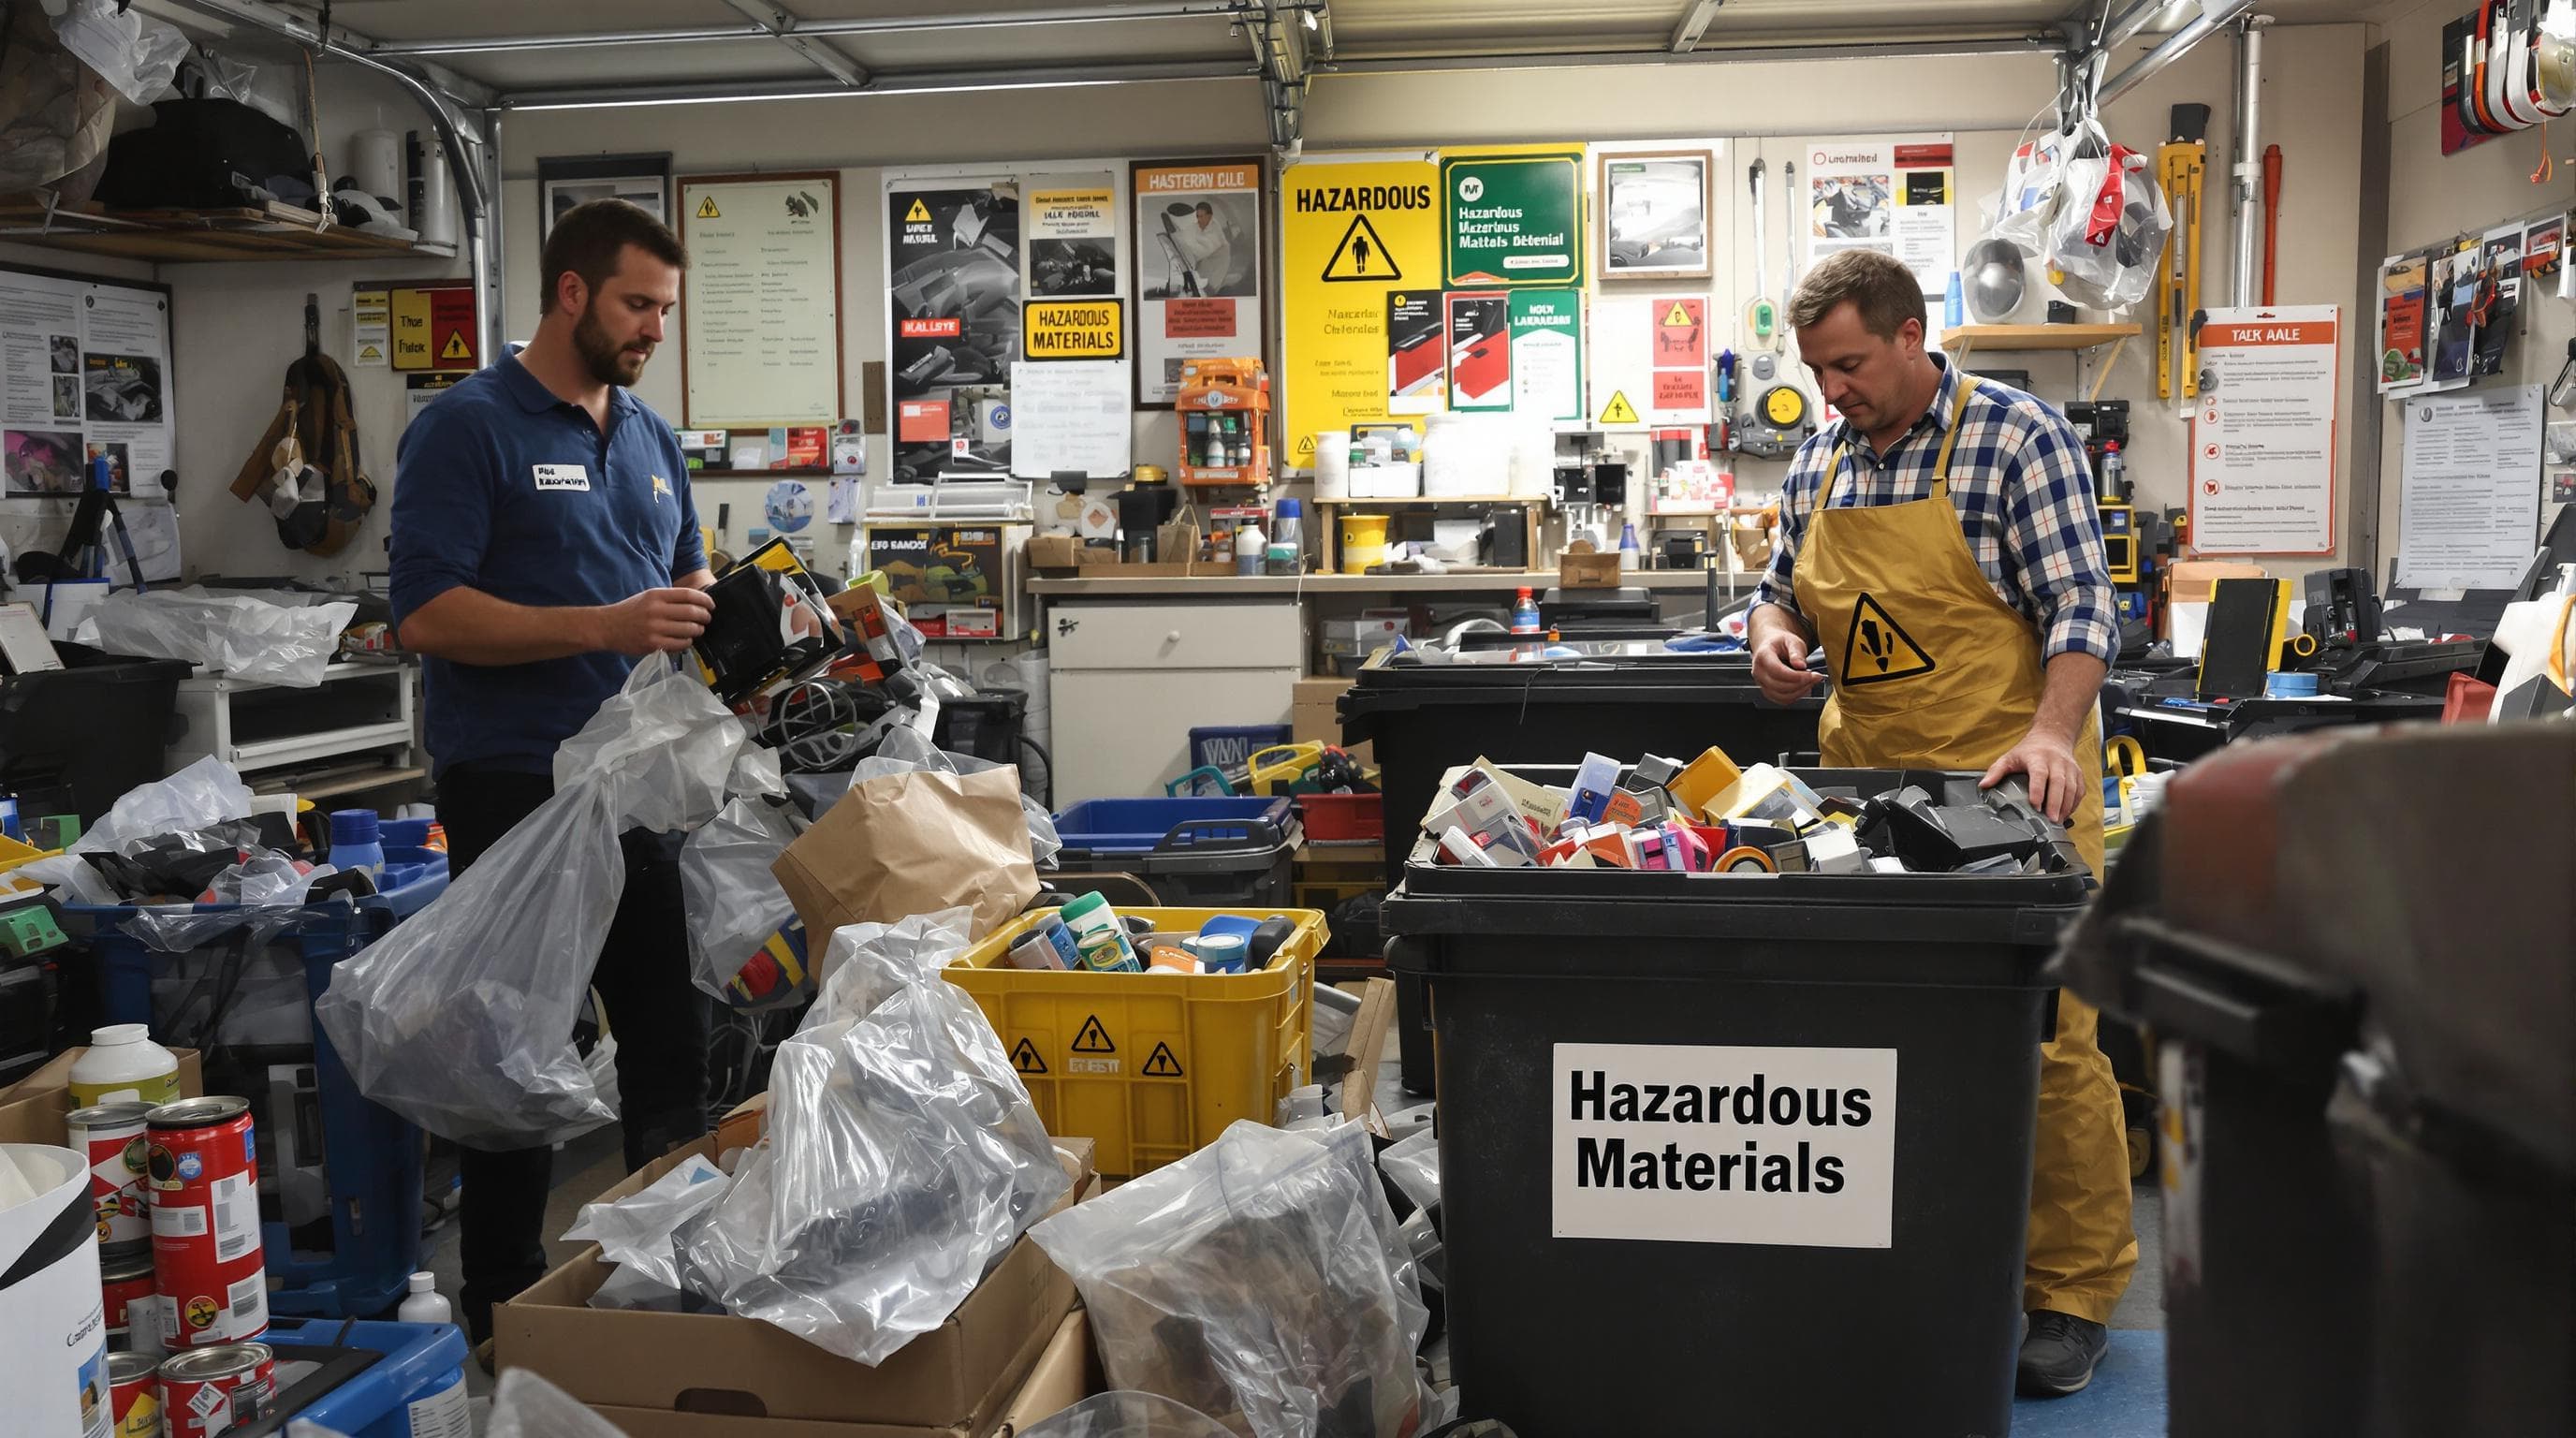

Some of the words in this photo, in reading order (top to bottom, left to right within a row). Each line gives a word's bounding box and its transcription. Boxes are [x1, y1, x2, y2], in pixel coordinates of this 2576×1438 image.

[1296, 185, 1431, 213] HAZARDOUS
[1039, 310, 1109, 327] HAZARDOUS
[1033, 331, 1114, 349] MATERIALS
[1571, 1070, 1873, 1127] Hazardous
[1577, 1137, 1845, 1194] Materials
